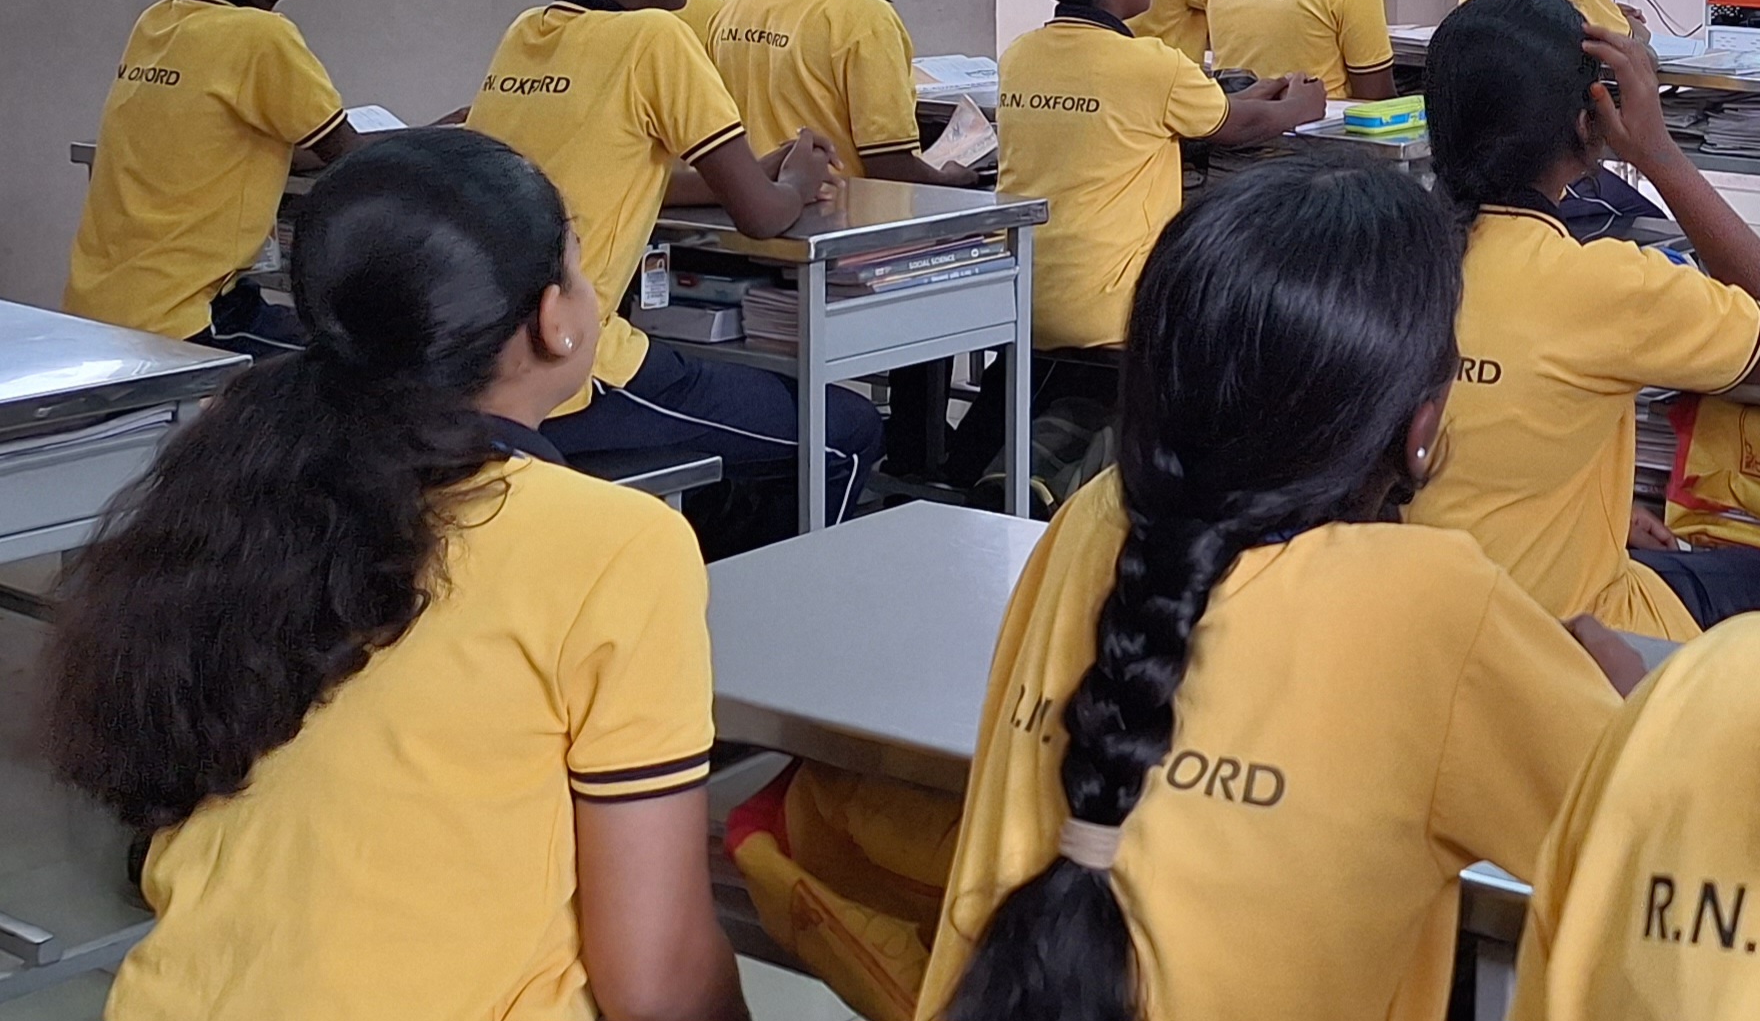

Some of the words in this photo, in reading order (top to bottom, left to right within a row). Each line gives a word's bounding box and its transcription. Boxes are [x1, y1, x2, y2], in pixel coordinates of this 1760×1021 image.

[999, 93, 1026, 109] R.N.
[1029, 94, 1101, 113] OXFORD
[1643, 874, 1757, 954] R.N.
